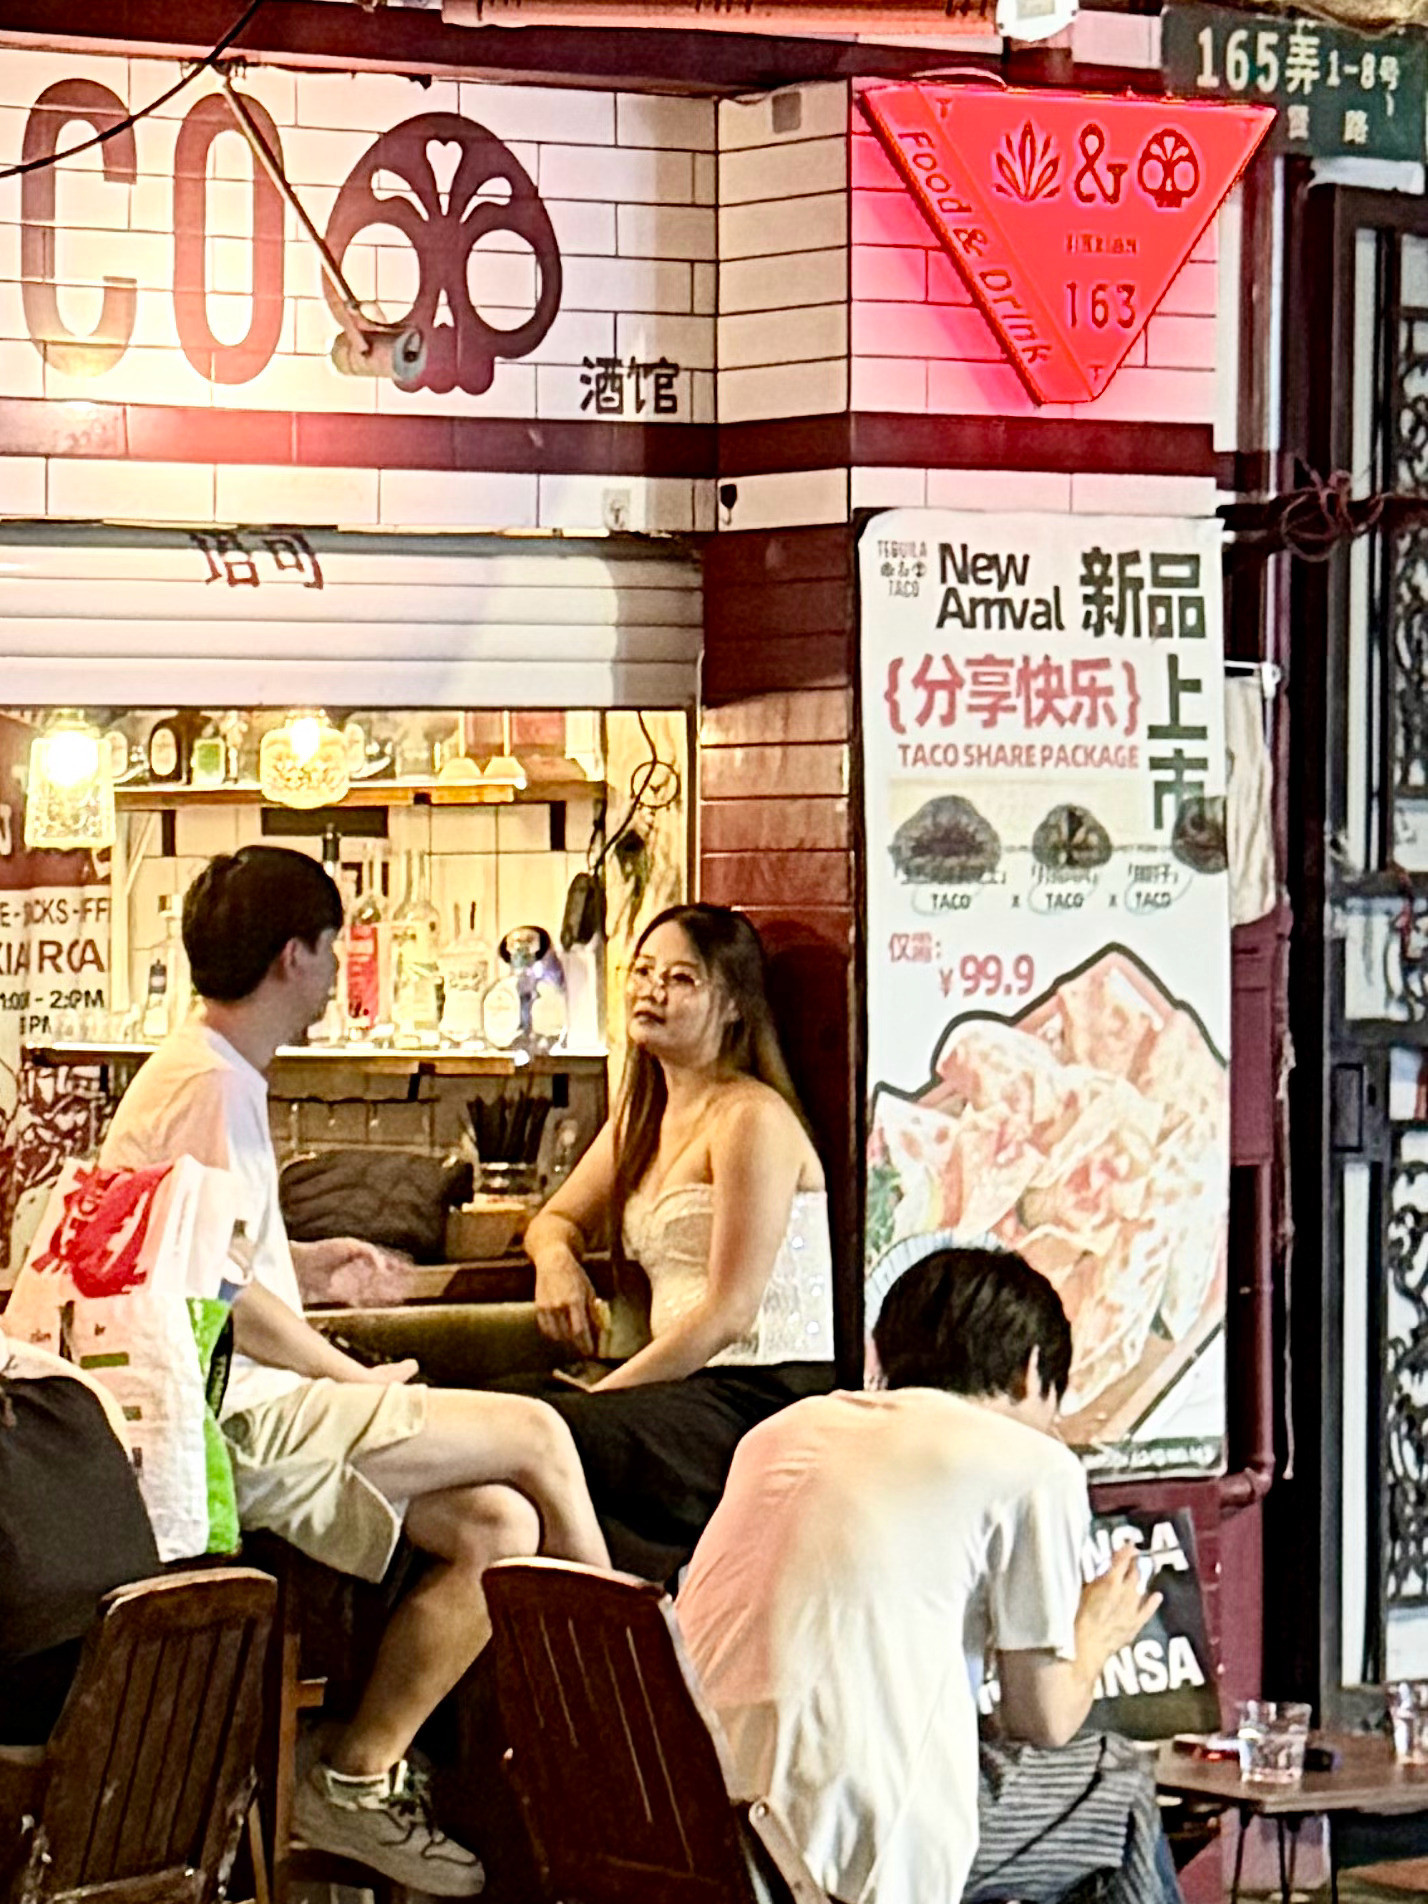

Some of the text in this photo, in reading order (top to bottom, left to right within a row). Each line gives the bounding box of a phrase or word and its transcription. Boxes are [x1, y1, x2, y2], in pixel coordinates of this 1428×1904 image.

[1074, 122, 1129, 204] &
[896, 131, 1053, 364] Food & Drink
[1065, 281, 1137, 329] 163
[579, 355, 680, 415] 酒馆
[937, 542, 1030, 592] New
[1079, 546, 1207, 639] 新品
[897, 743, 1139, 769] TACO SHARE PACKAGE
[932, 892, 973, 911] TACO
[1045, 892, 1085, 910] TACO
[1135, 891, 1172, 909] TACO
